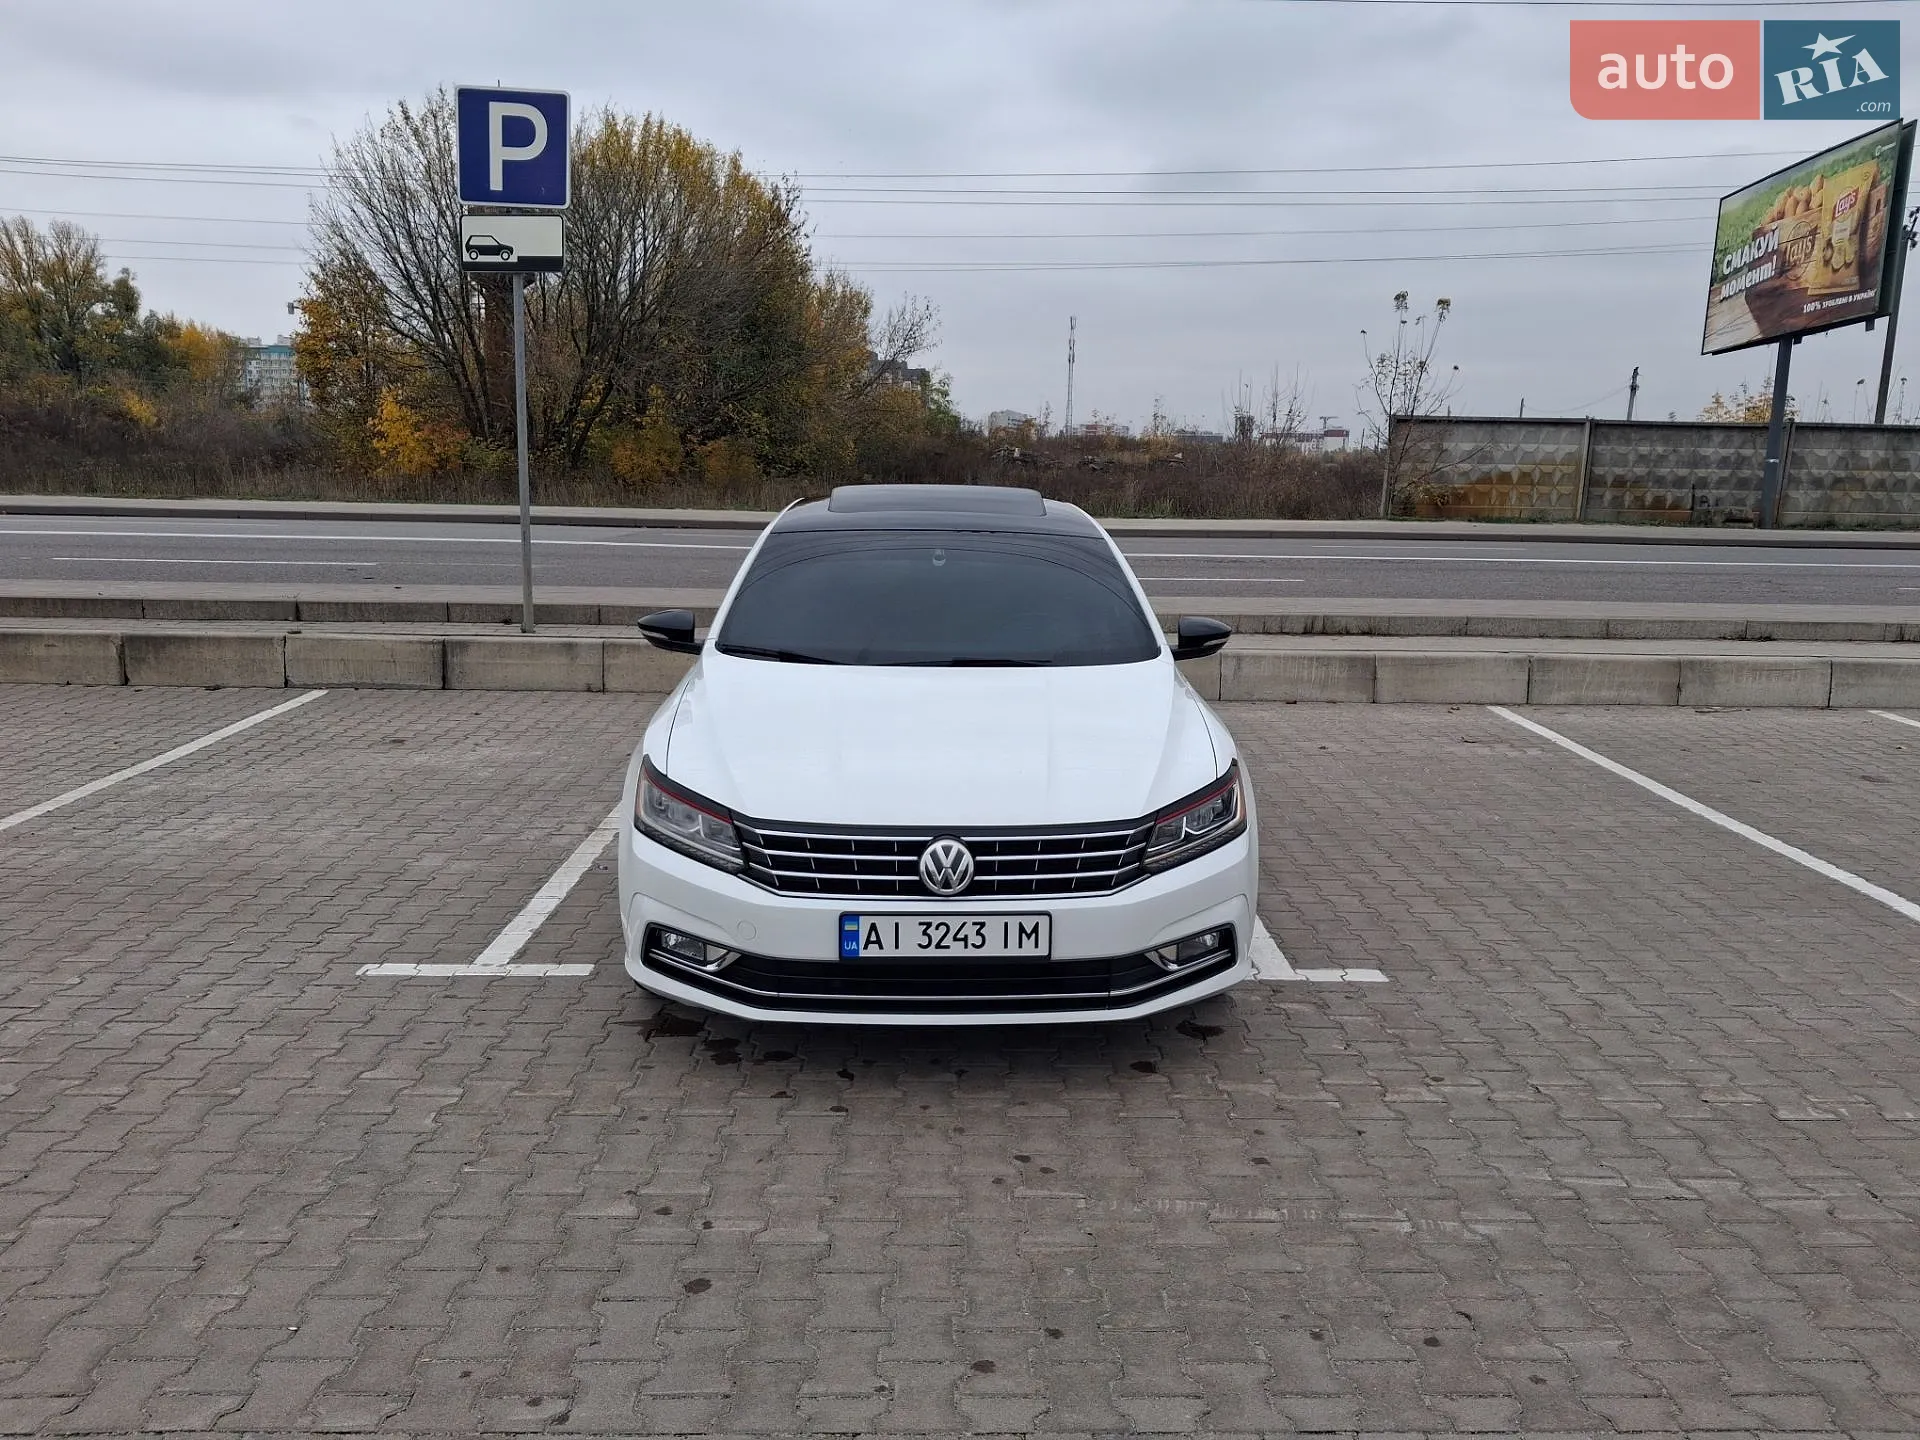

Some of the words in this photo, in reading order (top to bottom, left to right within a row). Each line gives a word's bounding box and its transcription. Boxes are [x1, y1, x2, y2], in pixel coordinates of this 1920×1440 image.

[488, 101, 548, 191] P
[1722, 223, 1780, 275] СМАКУЙ
[1803, 301, 1821, 313] 100%
[844, 941, 858, 950] UA
[863, 922, 900, 950] AI
[917, 921, 986, 950] 3243
[1003, 921, 1040, 950] IM
